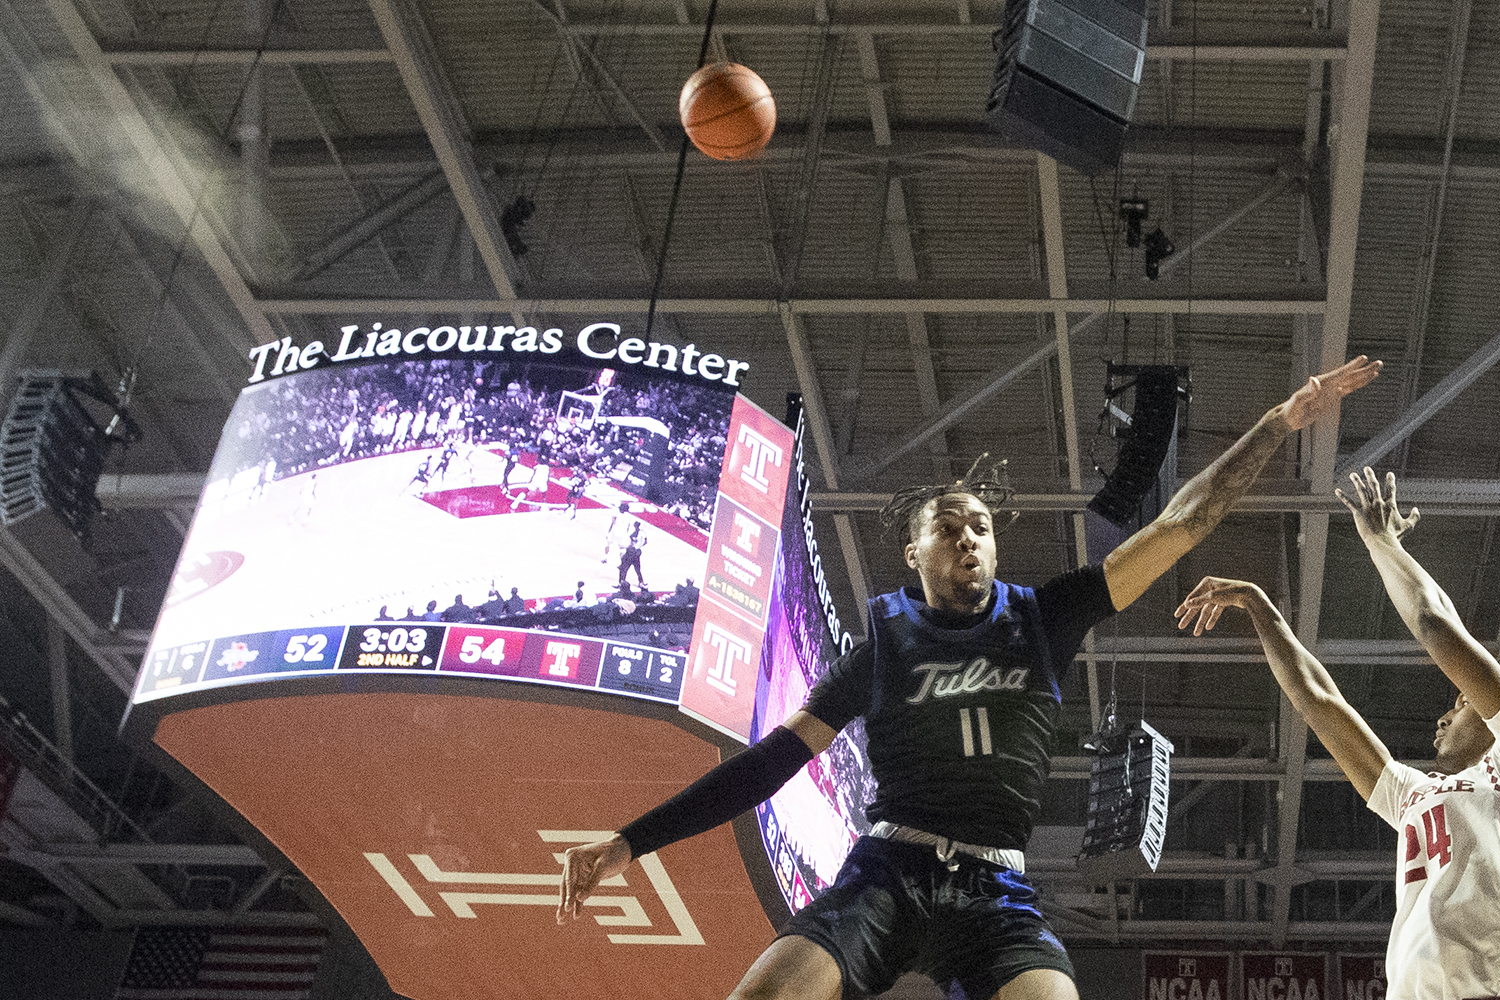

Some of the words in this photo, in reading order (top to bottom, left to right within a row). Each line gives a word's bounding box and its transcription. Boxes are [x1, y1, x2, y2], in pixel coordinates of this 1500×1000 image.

[248, 336, 324, 383] The
[331, 322, 563, 362] Liacouras
[577, 322, 750, 387] Center
[284, 634, 327, 663] 52
[360, 628, 428, 653] 3:03
[459, 635, 506, 666] 54
[357, 654, 385, 667] 2ND
[384, 654, 419, 667] HALF
[618, 659, 632, 675] 8
[660, 667, 673, 683] 2
[906, 656, 1030, 704] Tulsa
[959, 707, 993, 757] 11
